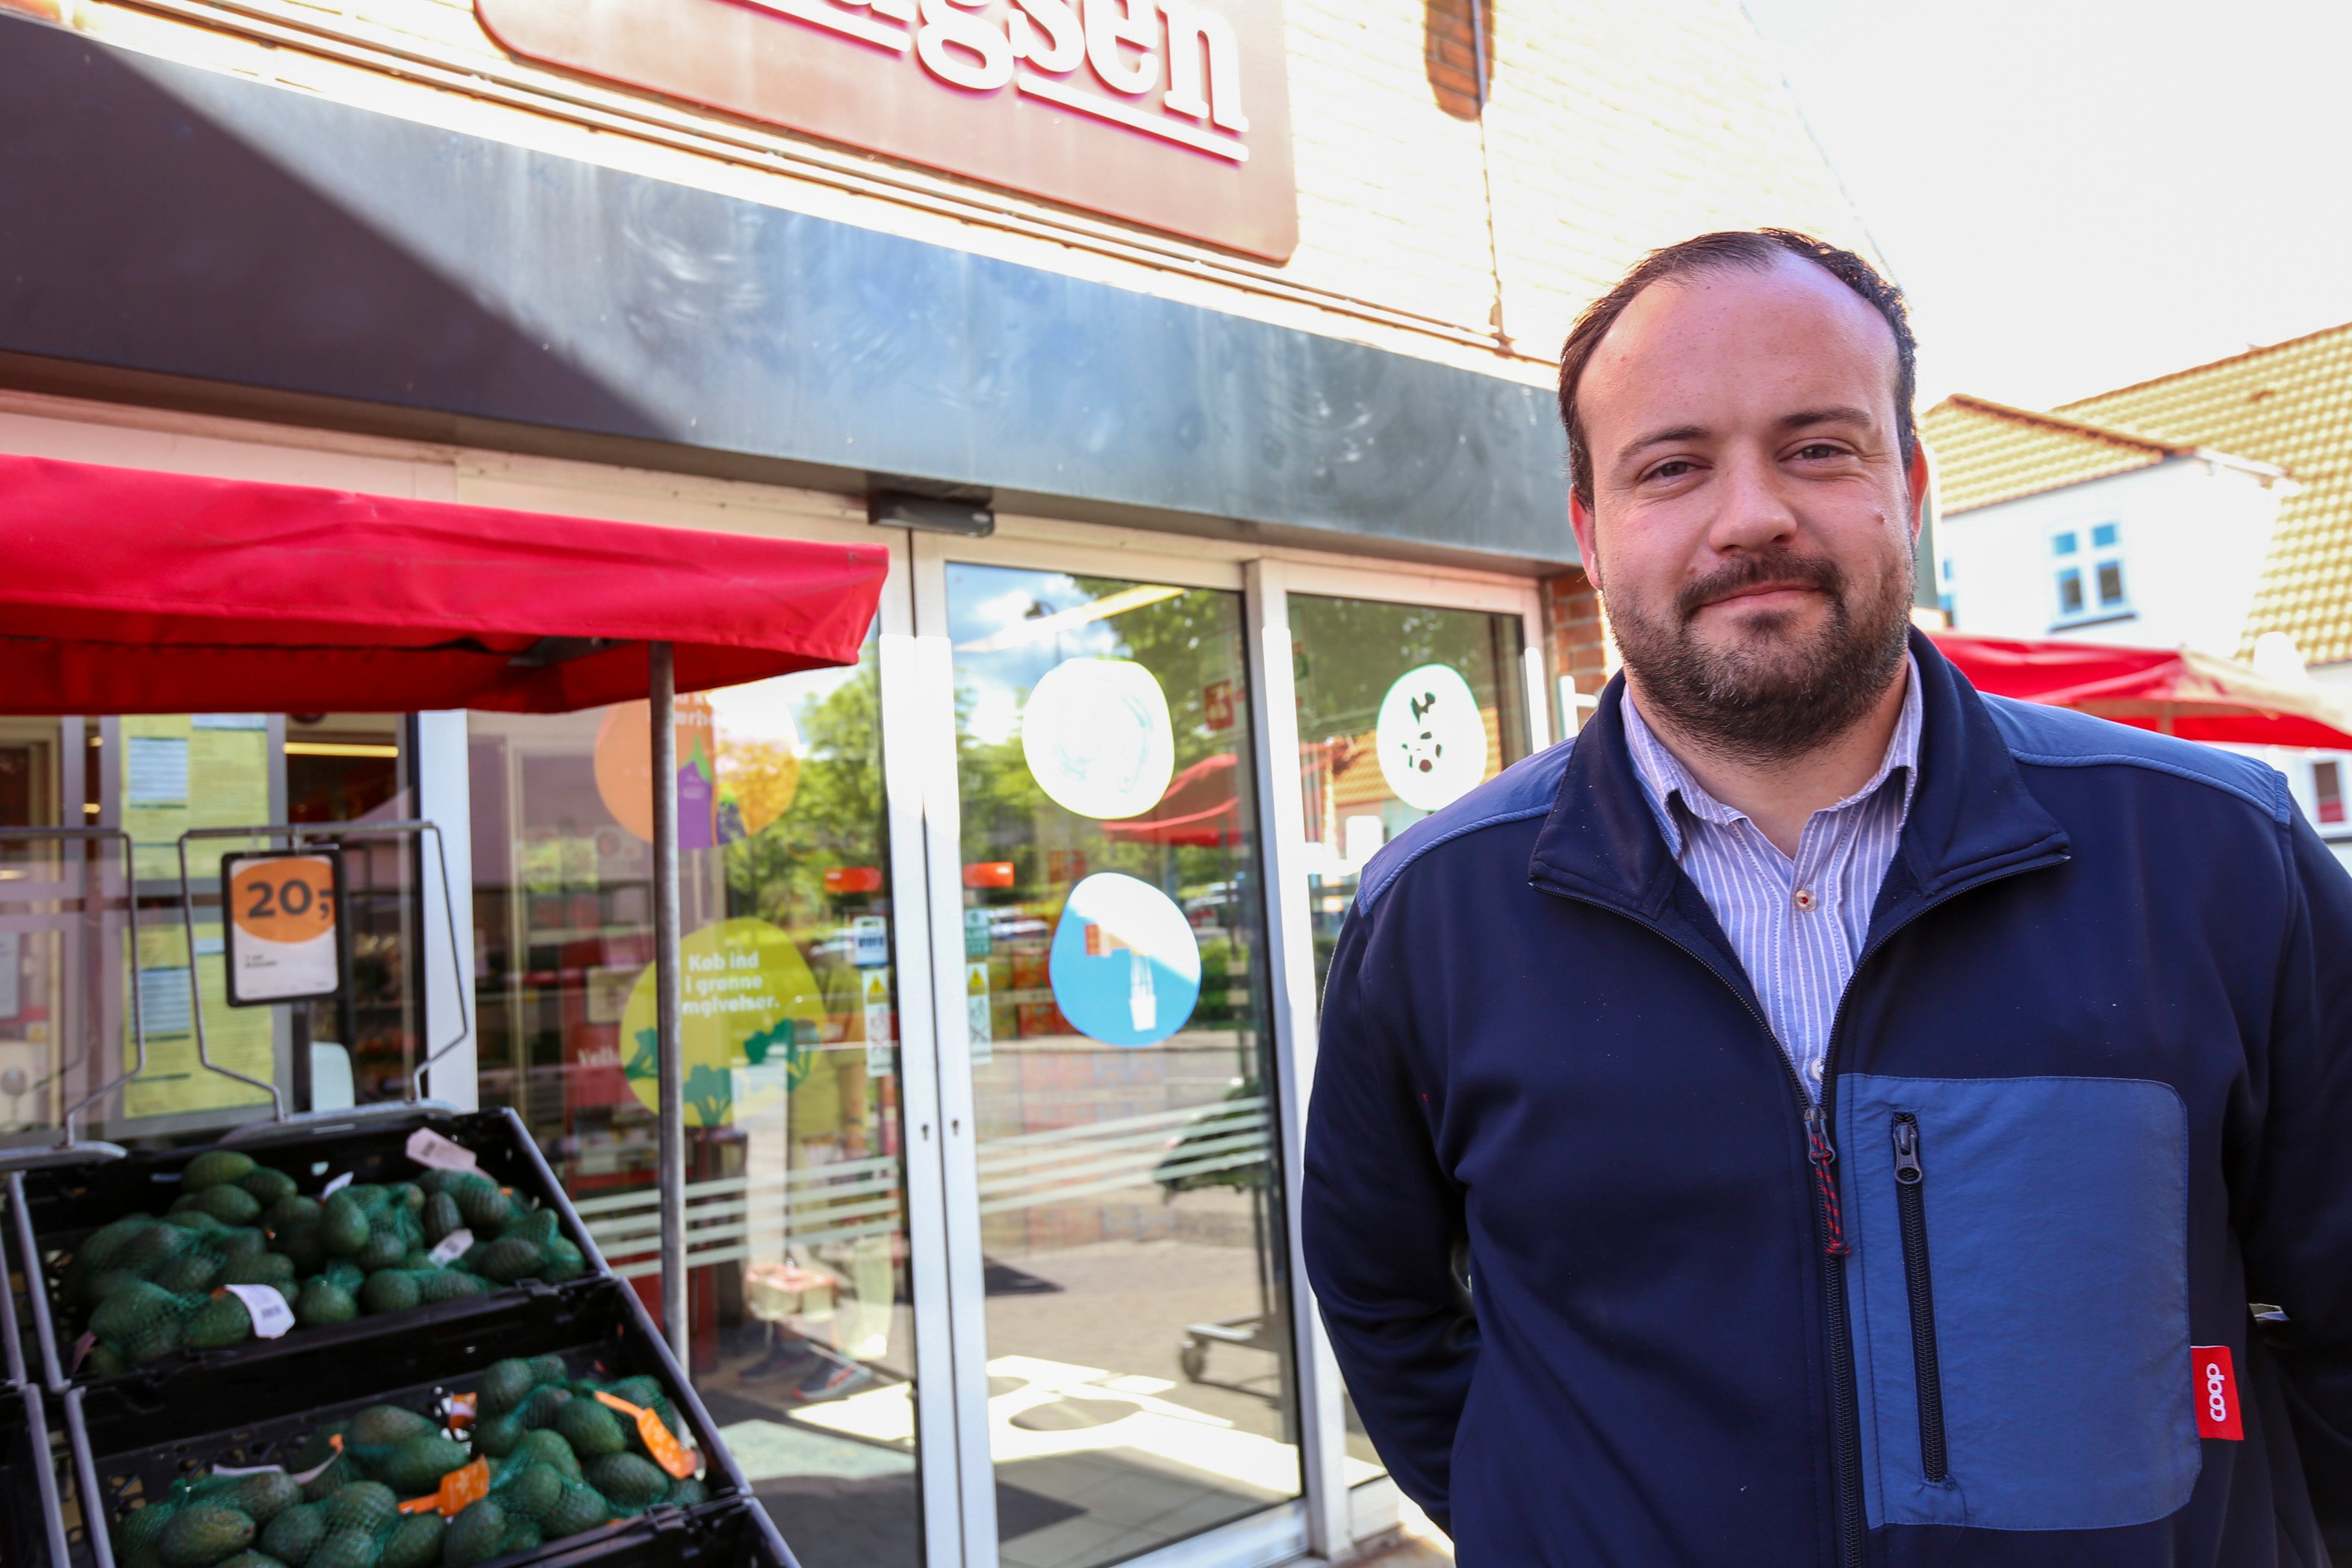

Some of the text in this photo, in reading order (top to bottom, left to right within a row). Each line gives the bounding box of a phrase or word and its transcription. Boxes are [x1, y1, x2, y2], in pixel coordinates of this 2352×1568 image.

[824, 0, 1249, 133] gsen
[680, 993, 781, 1018] mgivelser.
[2206, 1363, 2227, 1422] coop
